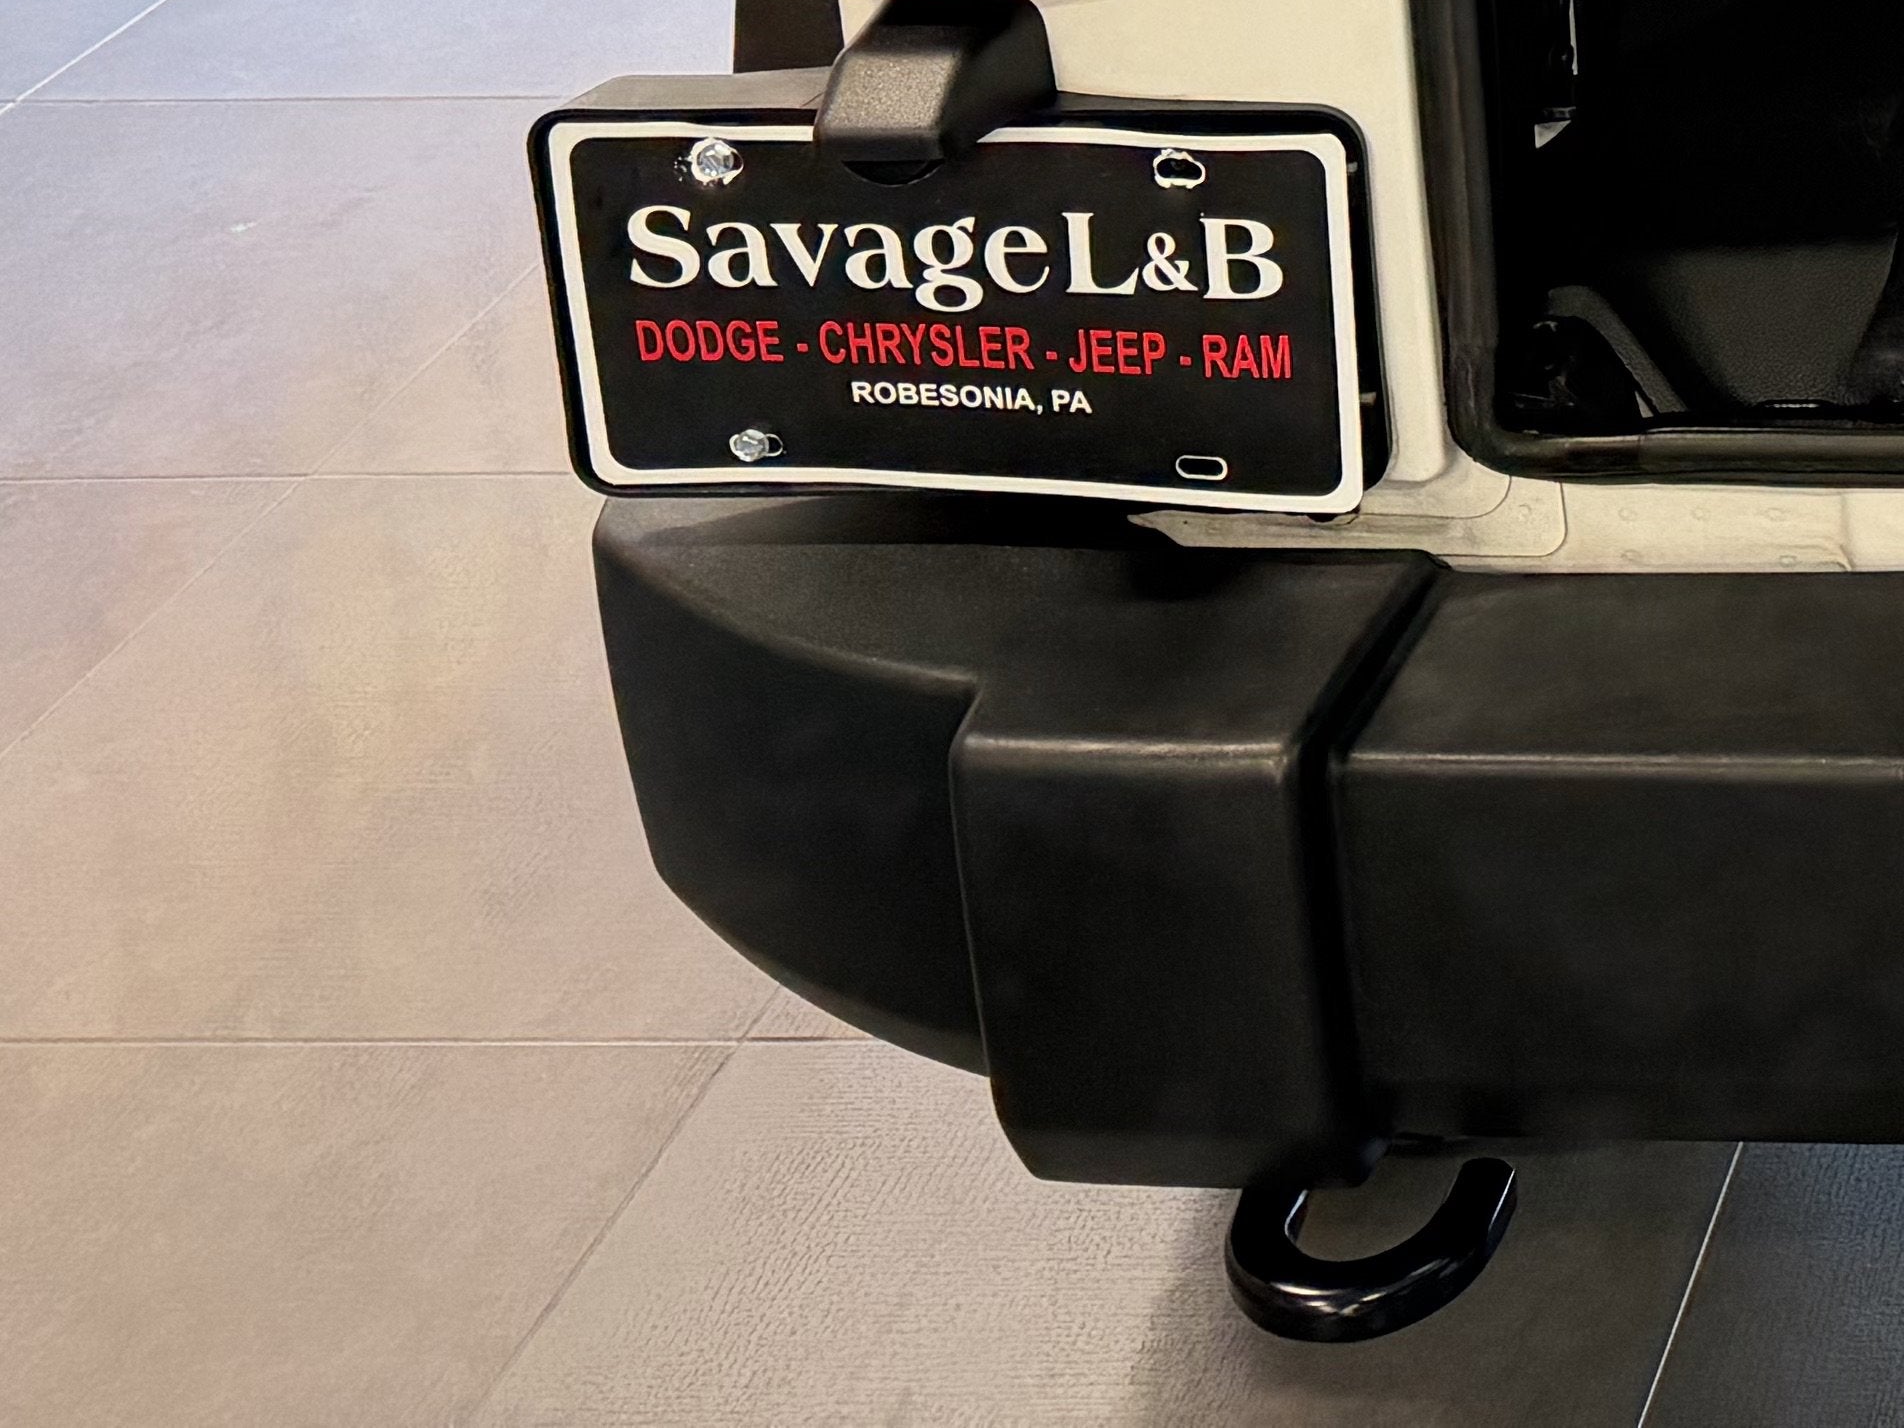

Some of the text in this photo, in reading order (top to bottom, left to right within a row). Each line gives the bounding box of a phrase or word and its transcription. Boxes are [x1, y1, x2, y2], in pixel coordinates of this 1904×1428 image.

[635, 319, 785, 362] DODGE
[819, 320, 1035, 370] CHRYSLER
[1068, 328, 1167, 379] JEEP
[1202, 334, 1292, 379] RAM
[850, 381, 1093, 415] ROBESONIA, PA
